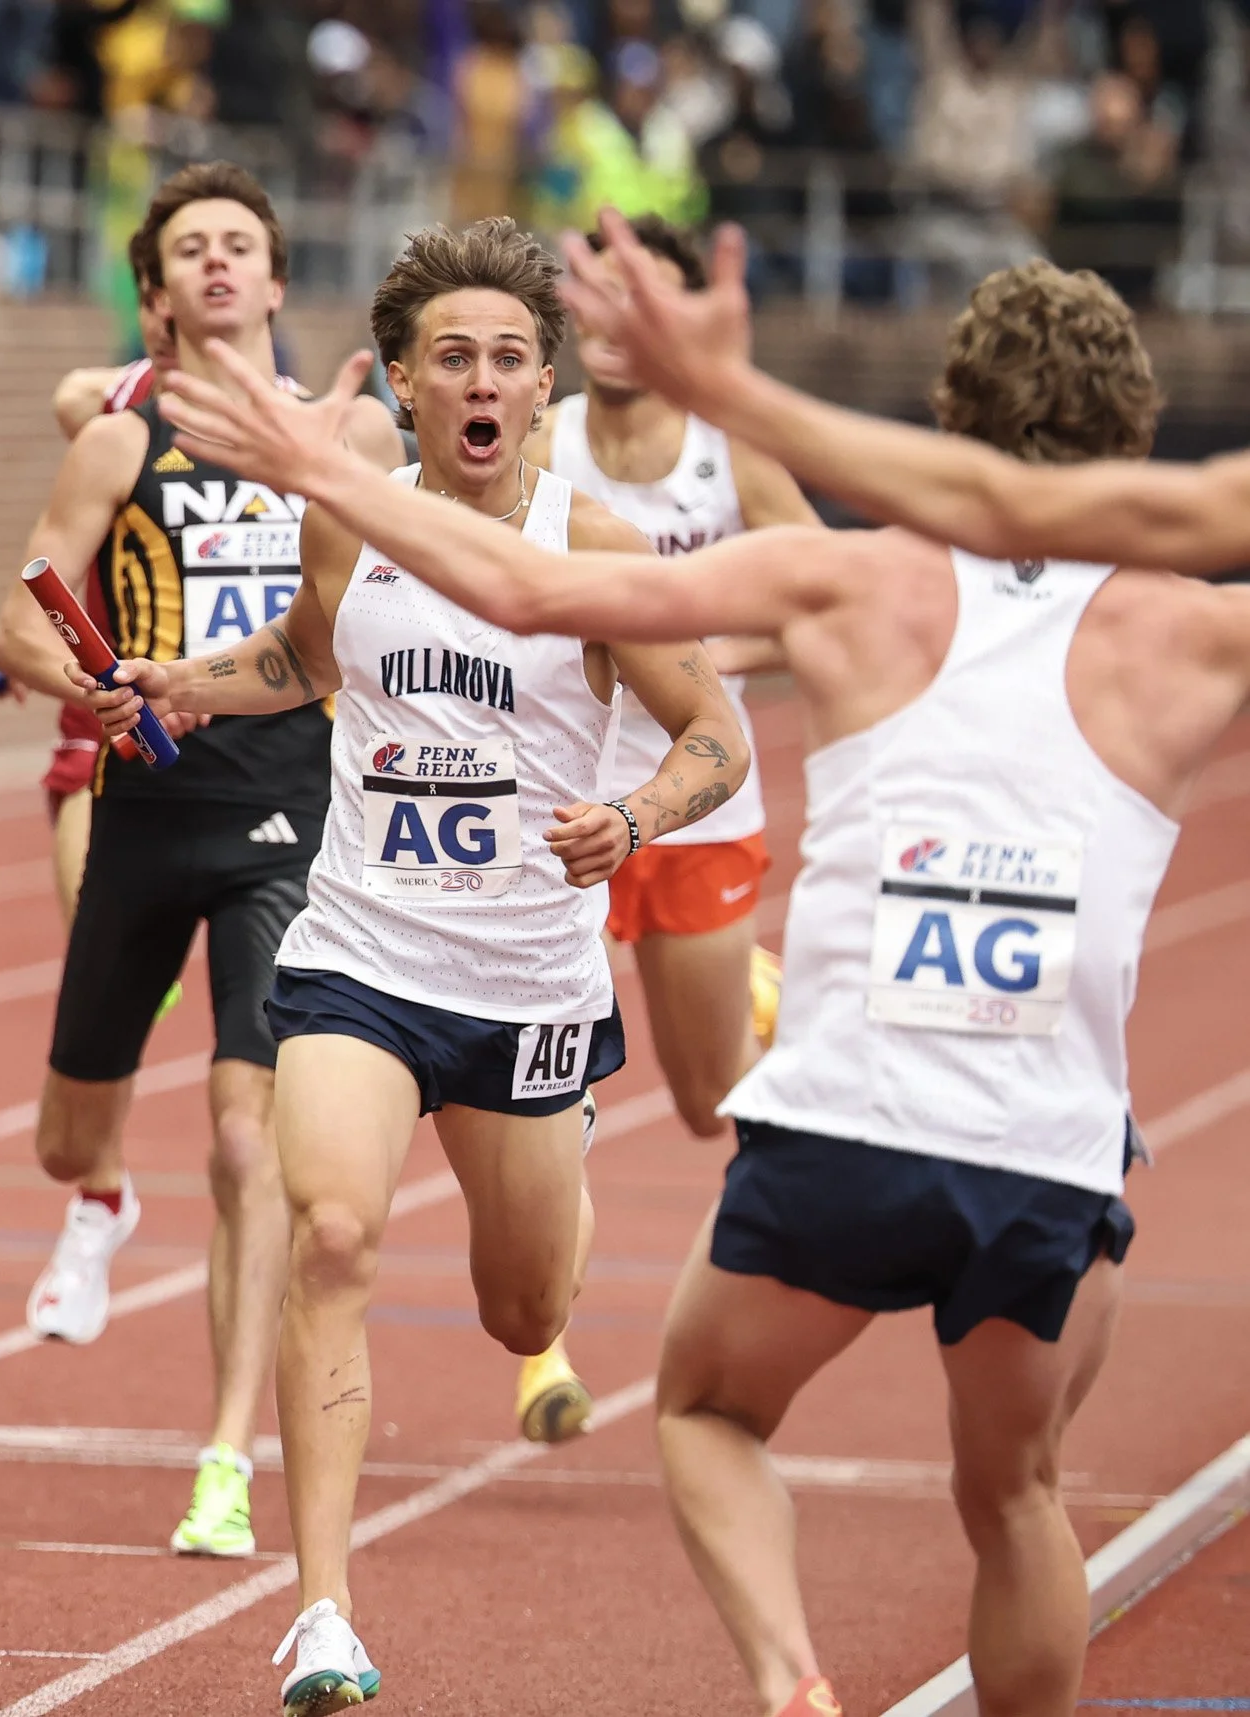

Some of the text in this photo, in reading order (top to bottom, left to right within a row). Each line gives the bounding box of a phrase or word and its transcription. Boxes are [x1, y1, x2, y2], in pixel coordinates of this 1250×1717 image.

[366, 573, 400, 583] EAST
[372, 565, 396, 575] BIG
[381, 648, 515, 714] VILLANOVA
[418, 746, 477, 762] PENN
[415, 762, 497, 778] RELAYS
[380, 801, 497, 866] AG
[394, 870, 483, 892] AMERICA 250
[894, 911, 1041, 993] AG
[525, 1024, 580, 1082] AG
[520, 1079, 575, 1092] PENN RELAYS
